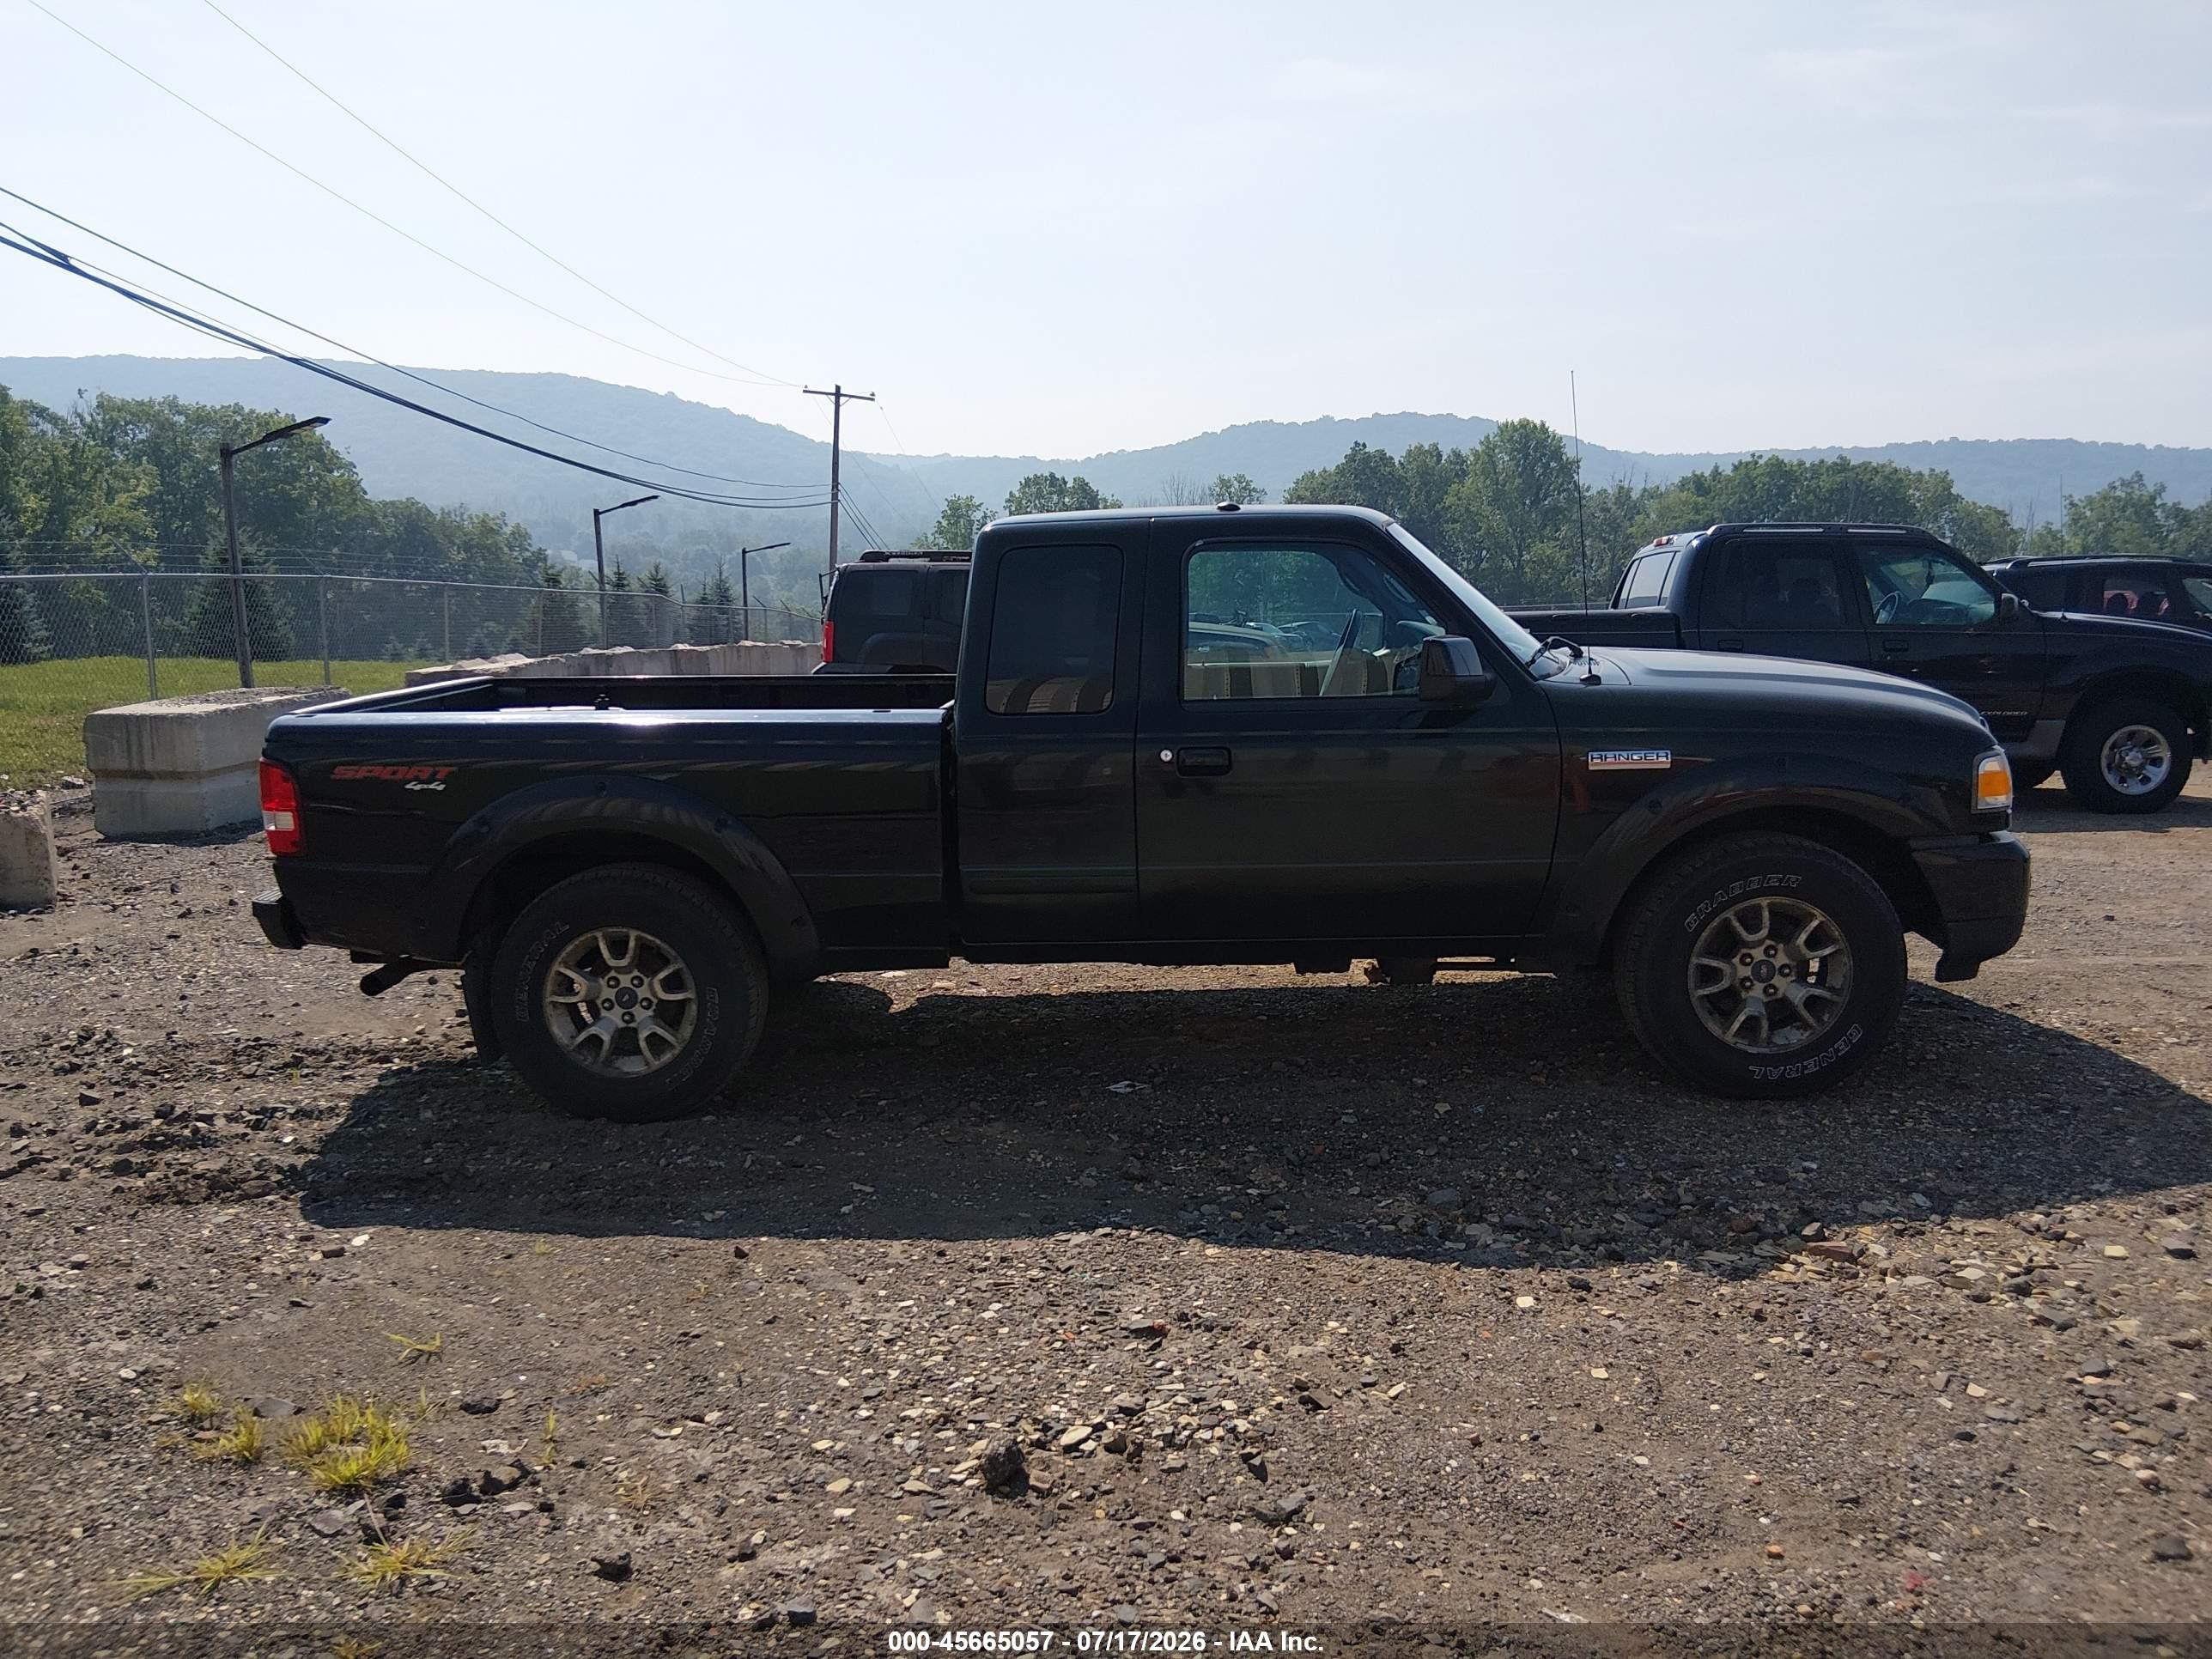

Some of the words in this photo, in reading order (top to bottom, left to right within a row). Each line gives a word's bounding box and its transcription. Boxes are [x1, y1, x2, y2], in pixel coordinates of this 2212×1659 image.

[332, 766, 454, 781] SPORT
[1590, 751, 1669, 763] RANGER
[1684, 874, 1802, 933] GRABBER
[1748, 1024, 1863, 1079] GENERAL
